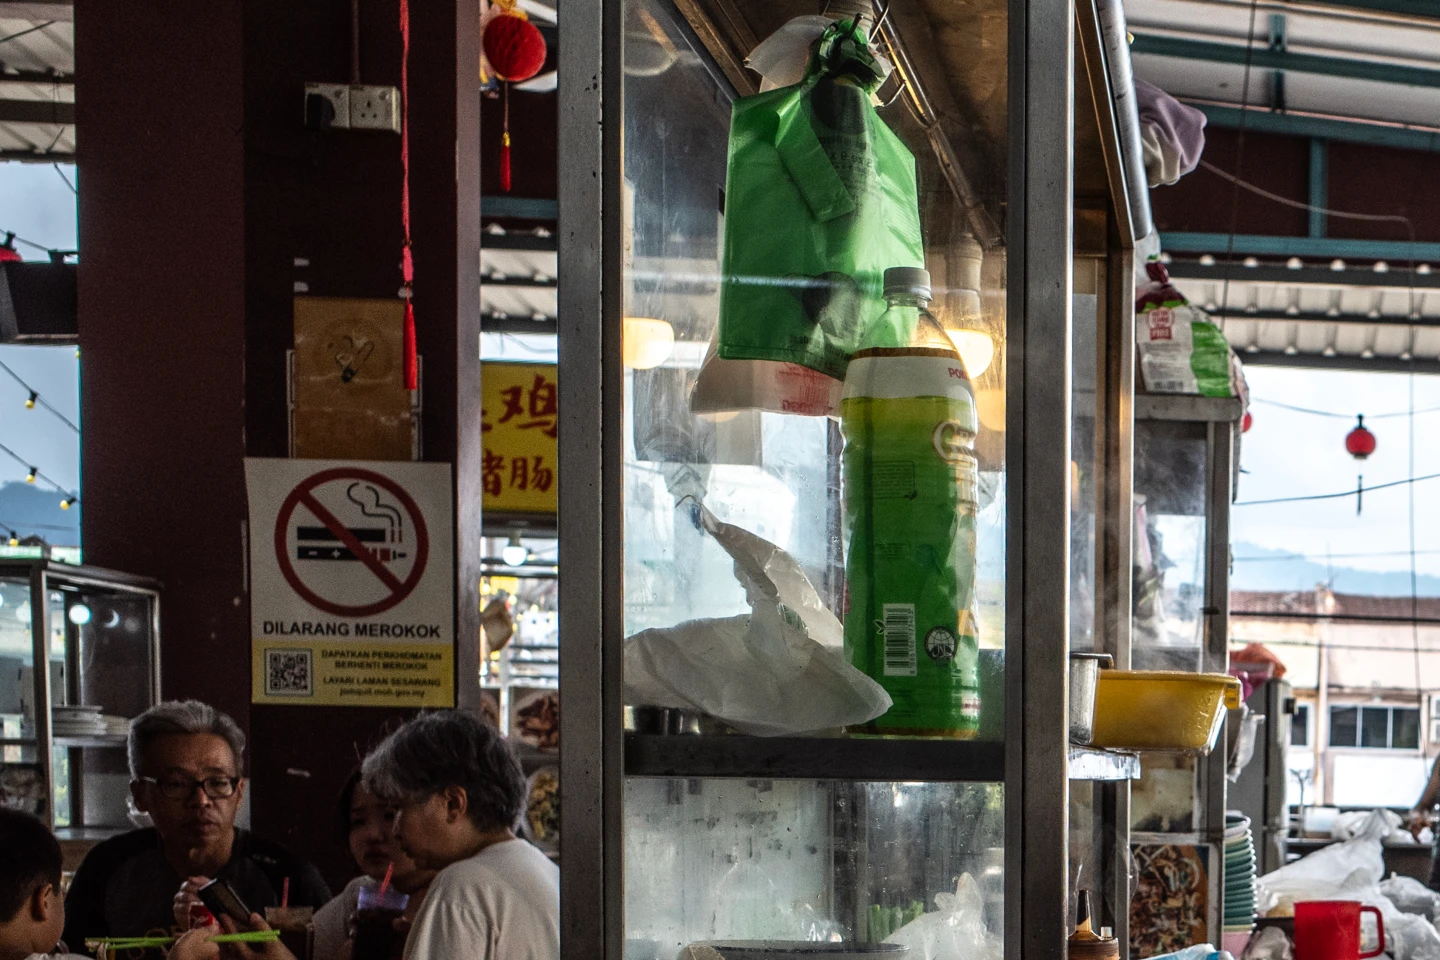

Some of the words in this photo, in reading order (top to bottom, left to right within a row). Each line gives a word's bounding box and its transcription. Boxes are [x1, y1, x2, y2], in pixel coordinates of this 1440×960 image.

[263, 621, 349, 636] DILARANG
[355, 622, 440, 638] MEROKOK
[321, 650, 370, 659] DAPATKAN
[335, 660, 380, 669] BERHENTI
[382, 661, 428, 670] MEROKOK
[323, 676, 354, 685] LAYARI
[356, 677, 388, 685] LAMAN
[391, 677, 441, 686] SESAWANG
